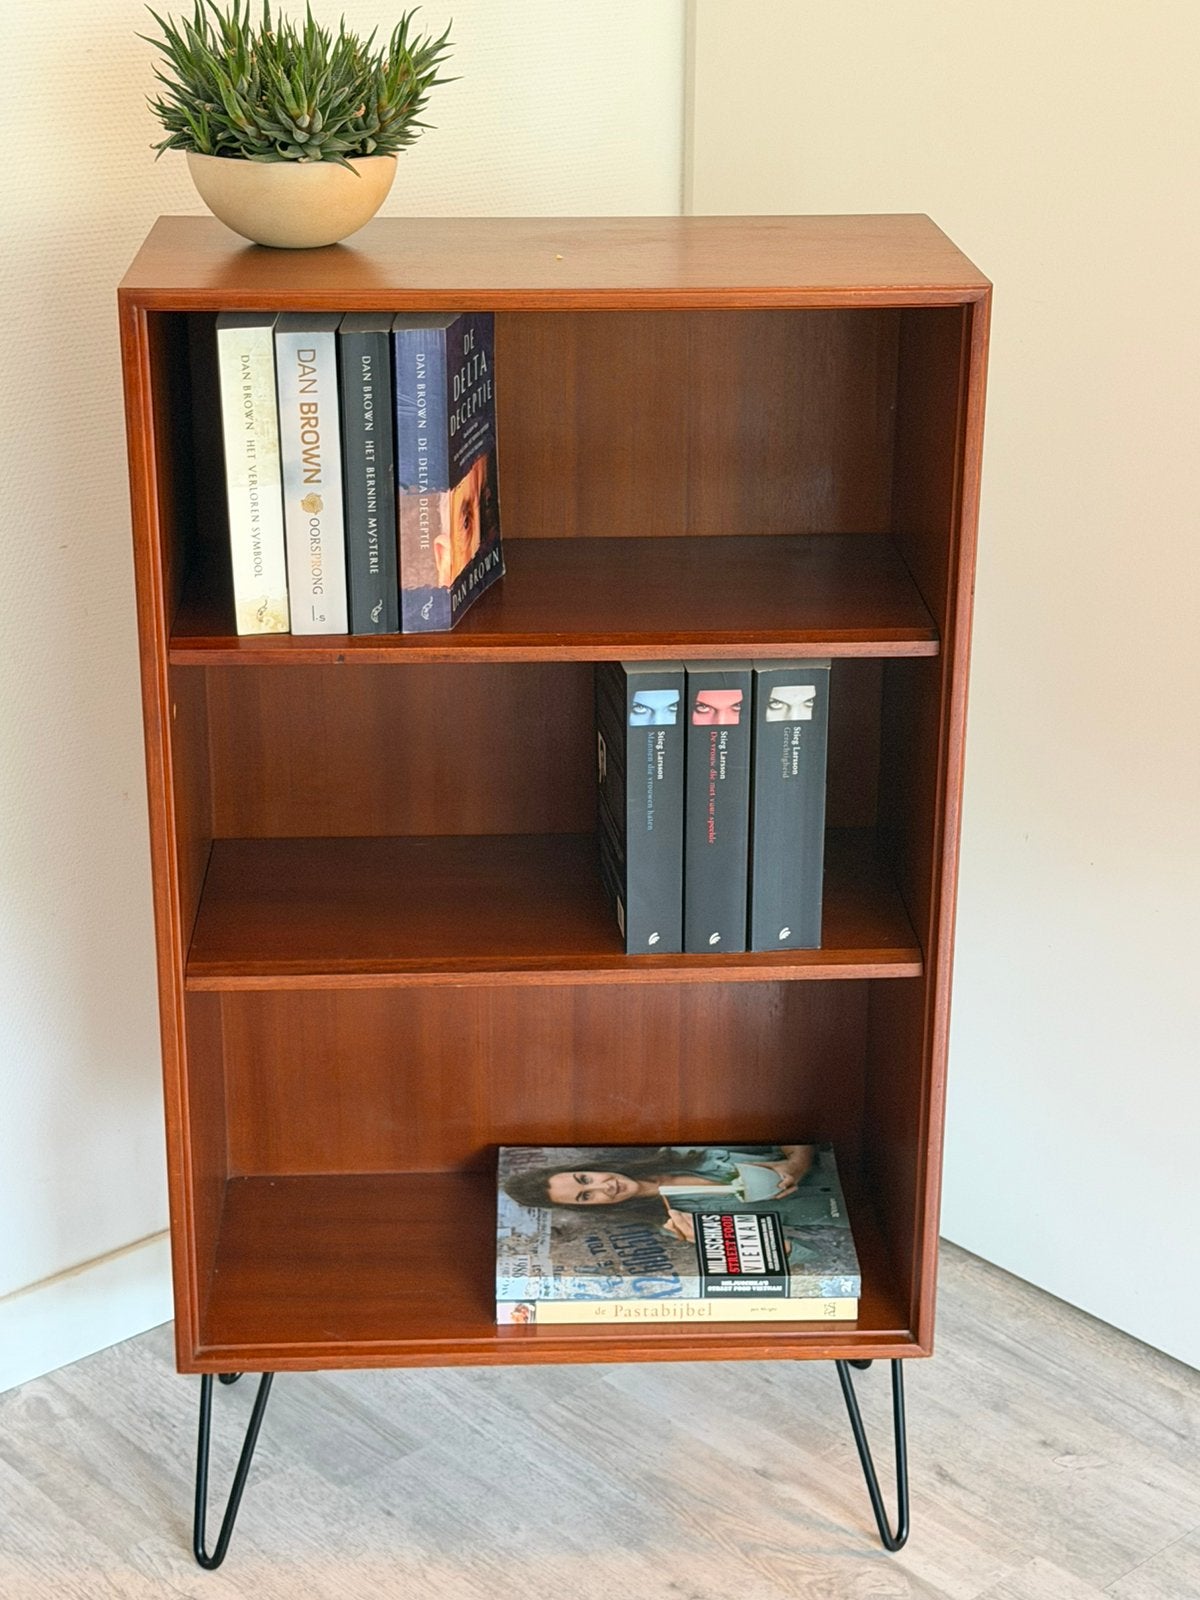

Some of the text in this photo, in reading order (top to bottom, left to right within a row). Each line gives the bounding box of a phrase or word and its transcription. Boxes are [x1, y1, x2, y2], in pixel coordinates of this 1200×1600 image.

[463, 328, 475, 355] DE
[453, 350, 488, 402] DELTA
[450, 379, 492, 437] DECEPTIE
[240, 355, 263, 578] DAN BROWN HET VERLOREN SYMBOOL
[297, 349, 324, 595] DAN BROWN OORSPRONG
[361, 355, 379, 574] DAN BROWN HET BERNINI MYSTERIE
[416, 353, 430, 551] DAN BROWN DE DELTA DECEPTIE
[452, 547, 499, 612] DAN BROWN
[647, 731, 655, 762] Mannen
[656, 731, 665, 780] Stieg Larsson
[710, 731, 718, 741] De
[718, 731, 728, 780] Stieg Larsson
[781, 726, 791, 779] Gerechtigheid
[792, 726, 801, 775] Stieg Larsson
[647, 763, 655, 775] die
[710, 768, 718, 780] die
[647, 810, 655, 831] haten
[707, 817, 716, 844] speelde
[720, 1215, 741, 1274] STREET FOOD
[736, 1214, 764, 1273] VIETNAM
[595, 1304, 713, 1319] de Pastabijbel
